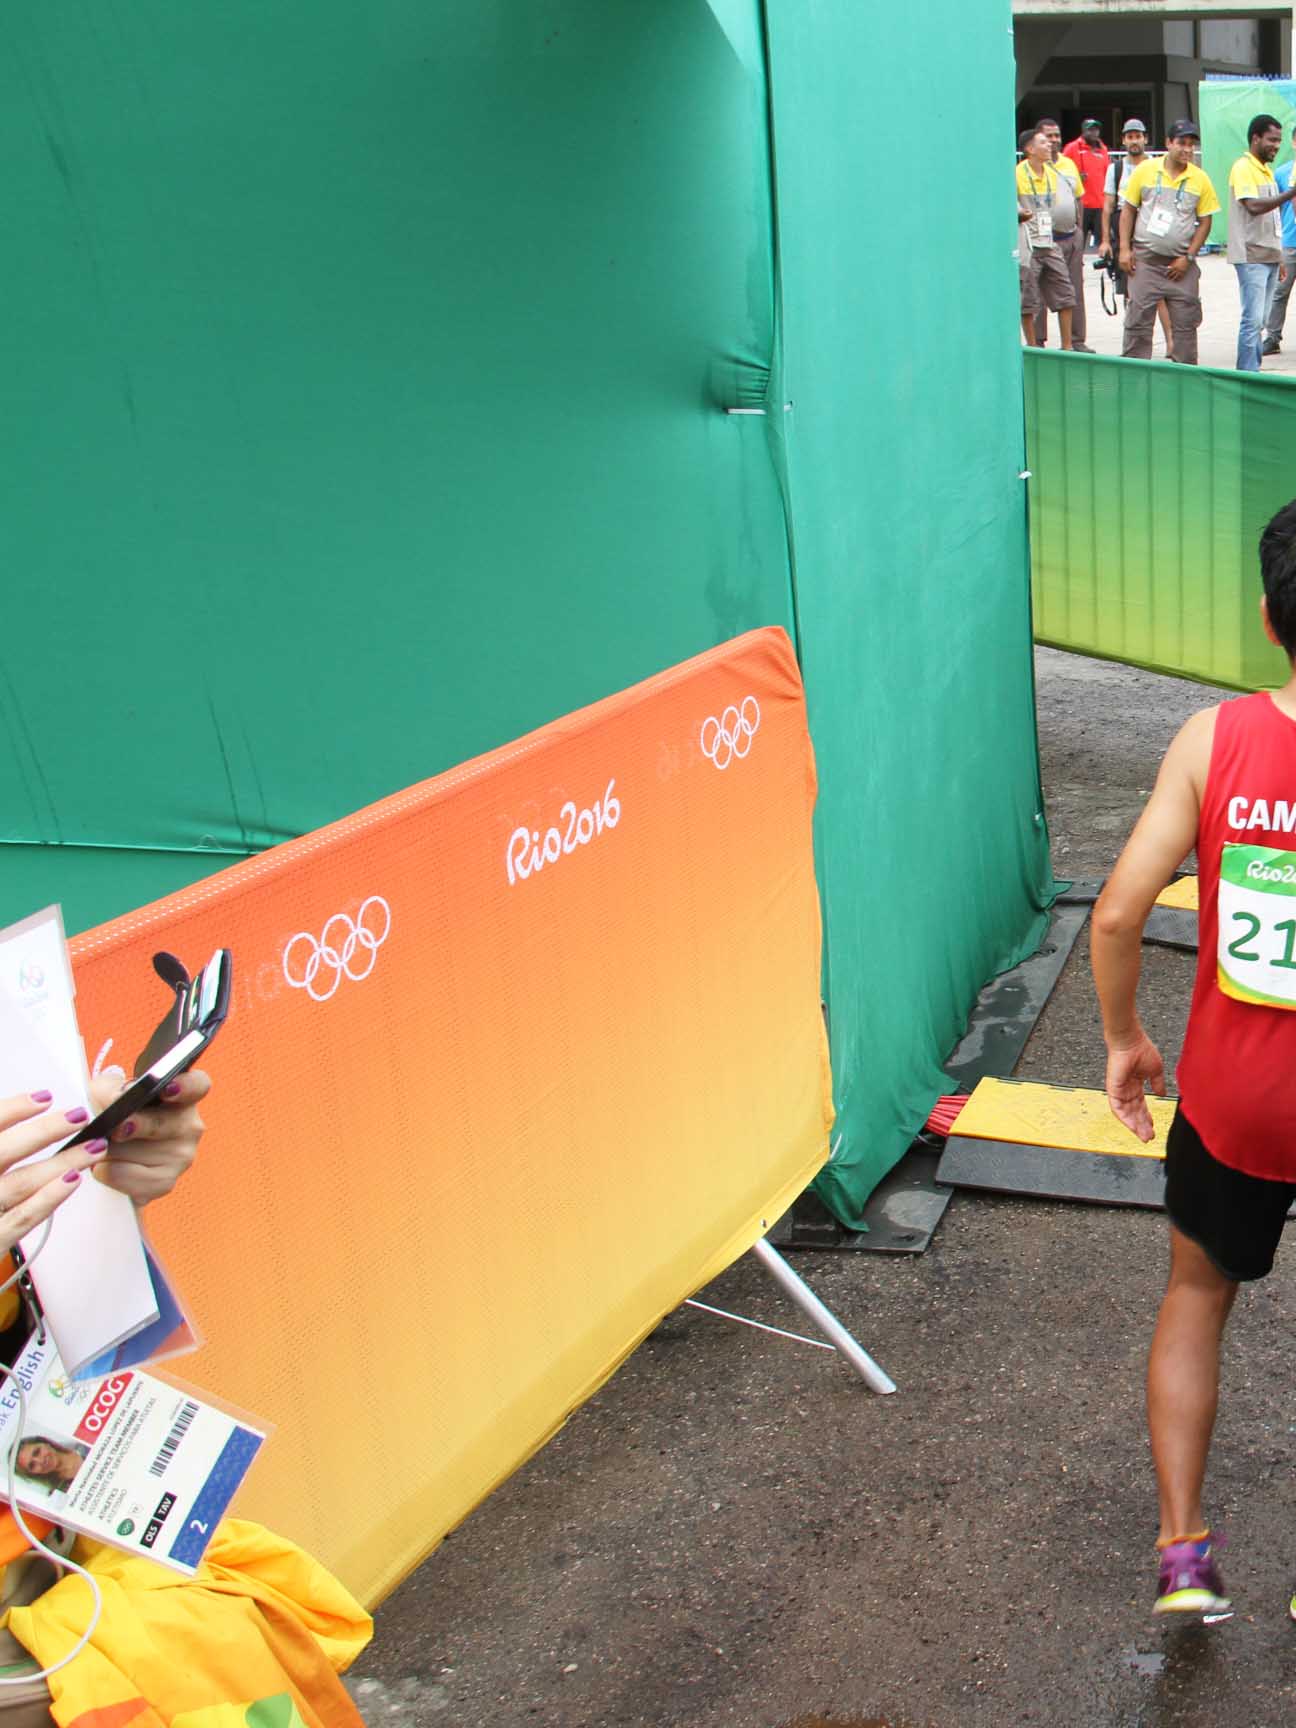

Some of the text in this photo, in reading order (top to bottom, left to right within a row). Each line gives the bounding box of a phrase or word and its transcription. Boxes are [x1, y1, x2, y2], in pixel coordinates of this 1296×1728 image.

[506, 777, 621, 886] Rio2016
[2, 1350, 45, 1409] English
[85, 1377, 125, 1432] OCOG
[144, 1498, 172, 1542] OLS TAV
[190, 1519, 208, 1535] 2
